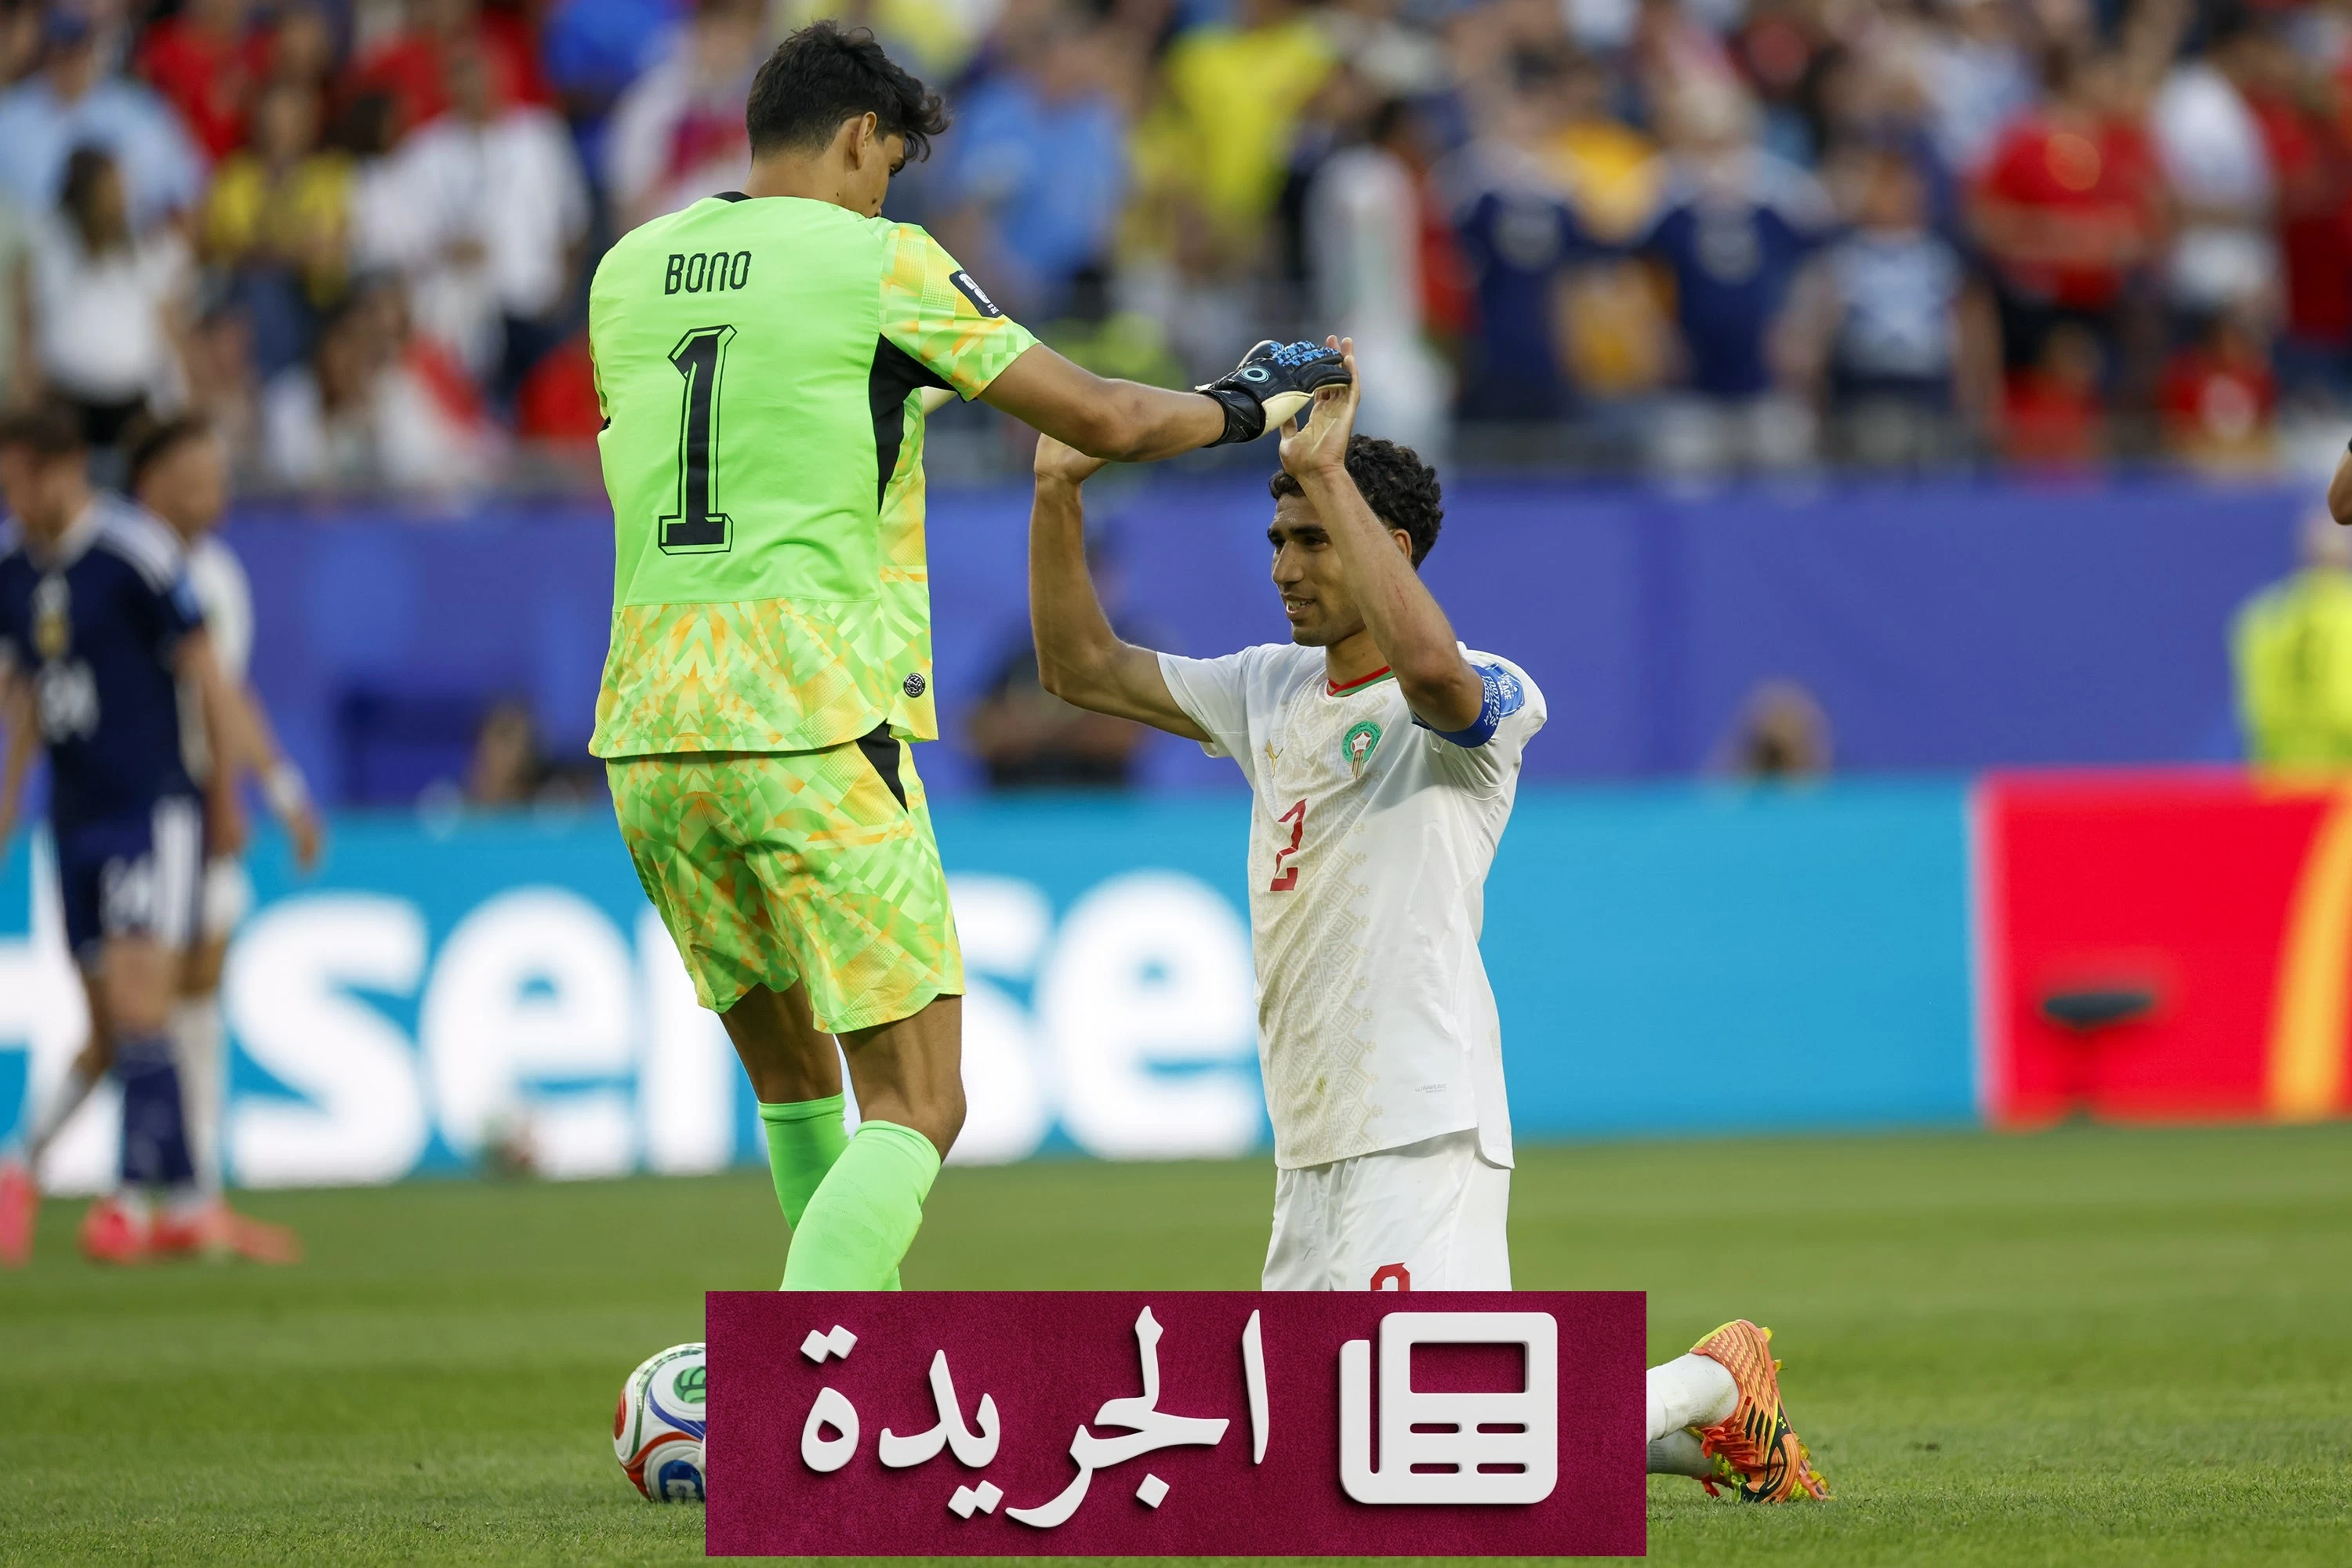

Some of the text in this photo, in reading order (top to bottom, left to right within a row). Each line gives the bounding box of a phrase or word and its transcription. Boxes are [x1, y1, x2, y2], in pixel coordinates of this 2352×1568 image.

[664, 251, 752, 296] BONO
[657, 324, 738, 556] 1
[1269, 798, 1308, 891] 2
[0, 823, 1259, 1196] sese
